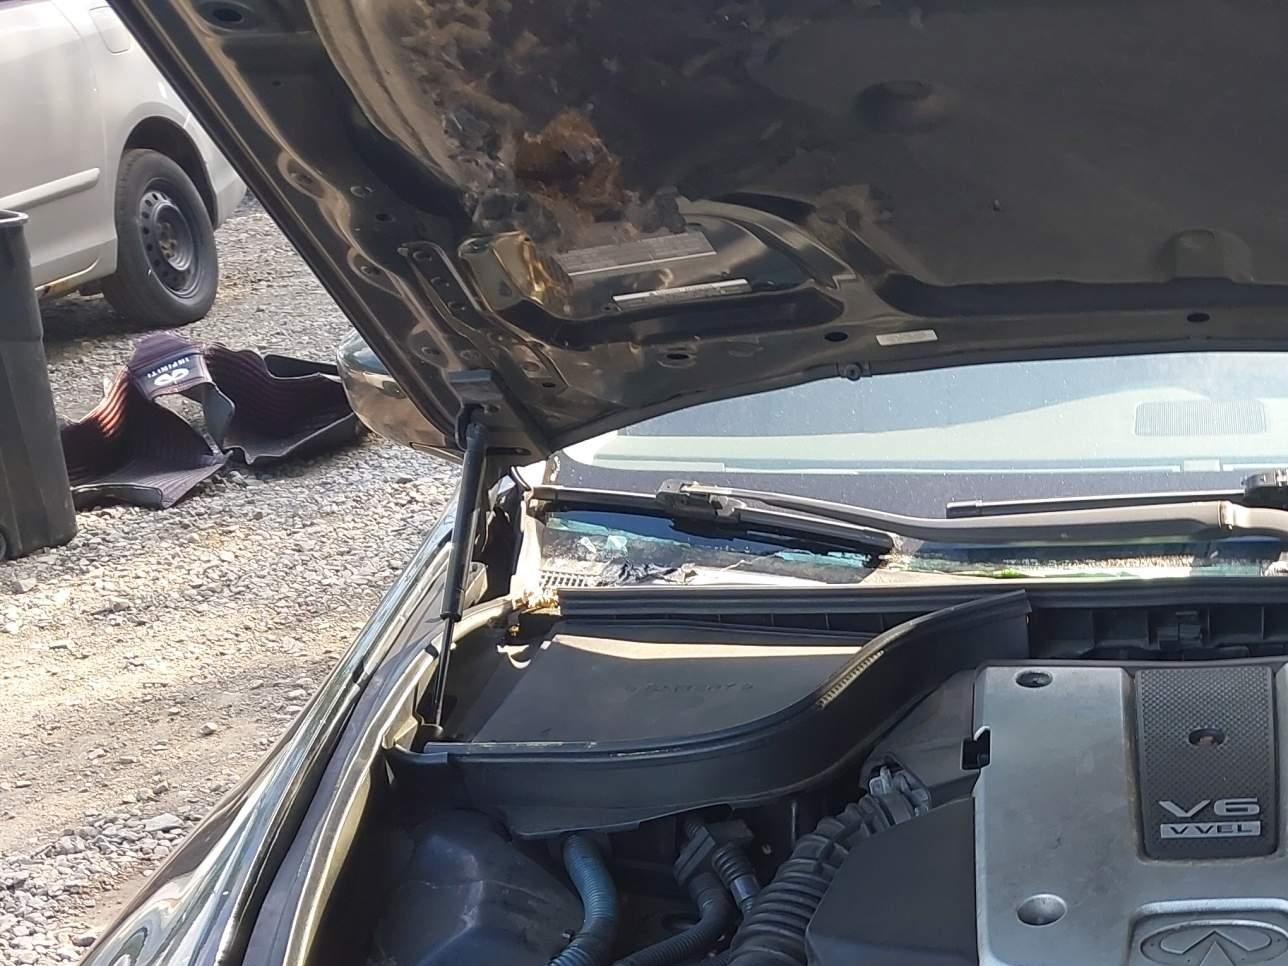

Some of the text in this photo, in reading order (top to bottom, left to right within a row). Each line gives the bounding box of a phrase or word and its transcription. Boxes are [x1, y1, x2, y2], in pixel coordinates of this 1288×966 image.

[146, 357, 190, 378] INFINITI
[1158, 797, 1260, 818] V6
[1170, 823, 1253, 835] VVEL
